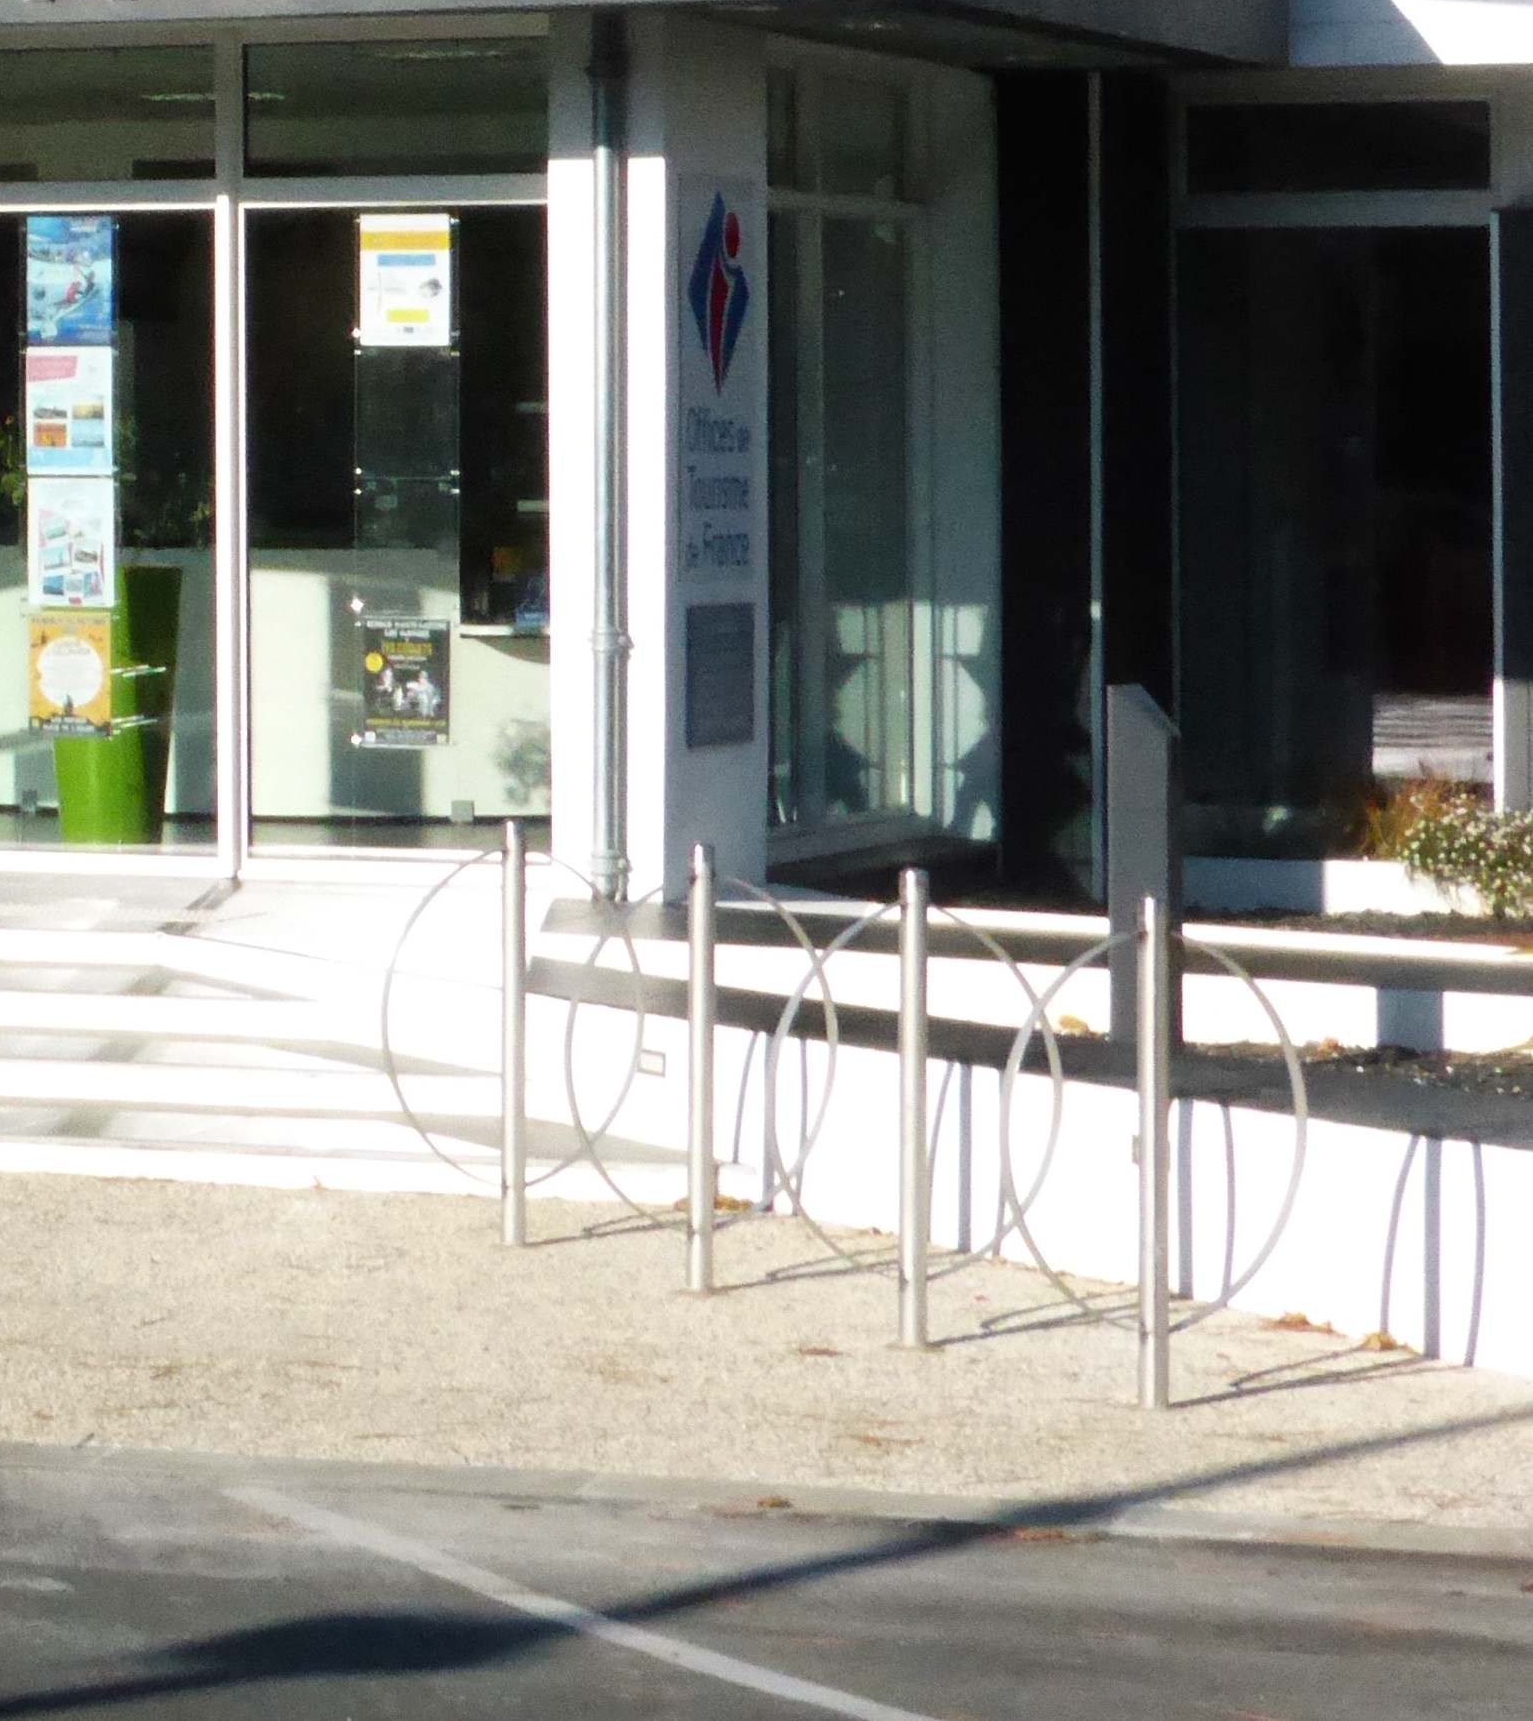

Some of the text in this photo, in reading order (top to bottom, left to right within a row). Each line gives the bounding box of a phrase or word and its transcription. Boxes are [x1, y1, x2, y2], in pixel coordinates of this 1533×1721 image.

[686, 407, 735, 454] Offices
[686, 464, 750, 511] Tourisme
[702, 522, 750, 567] France
